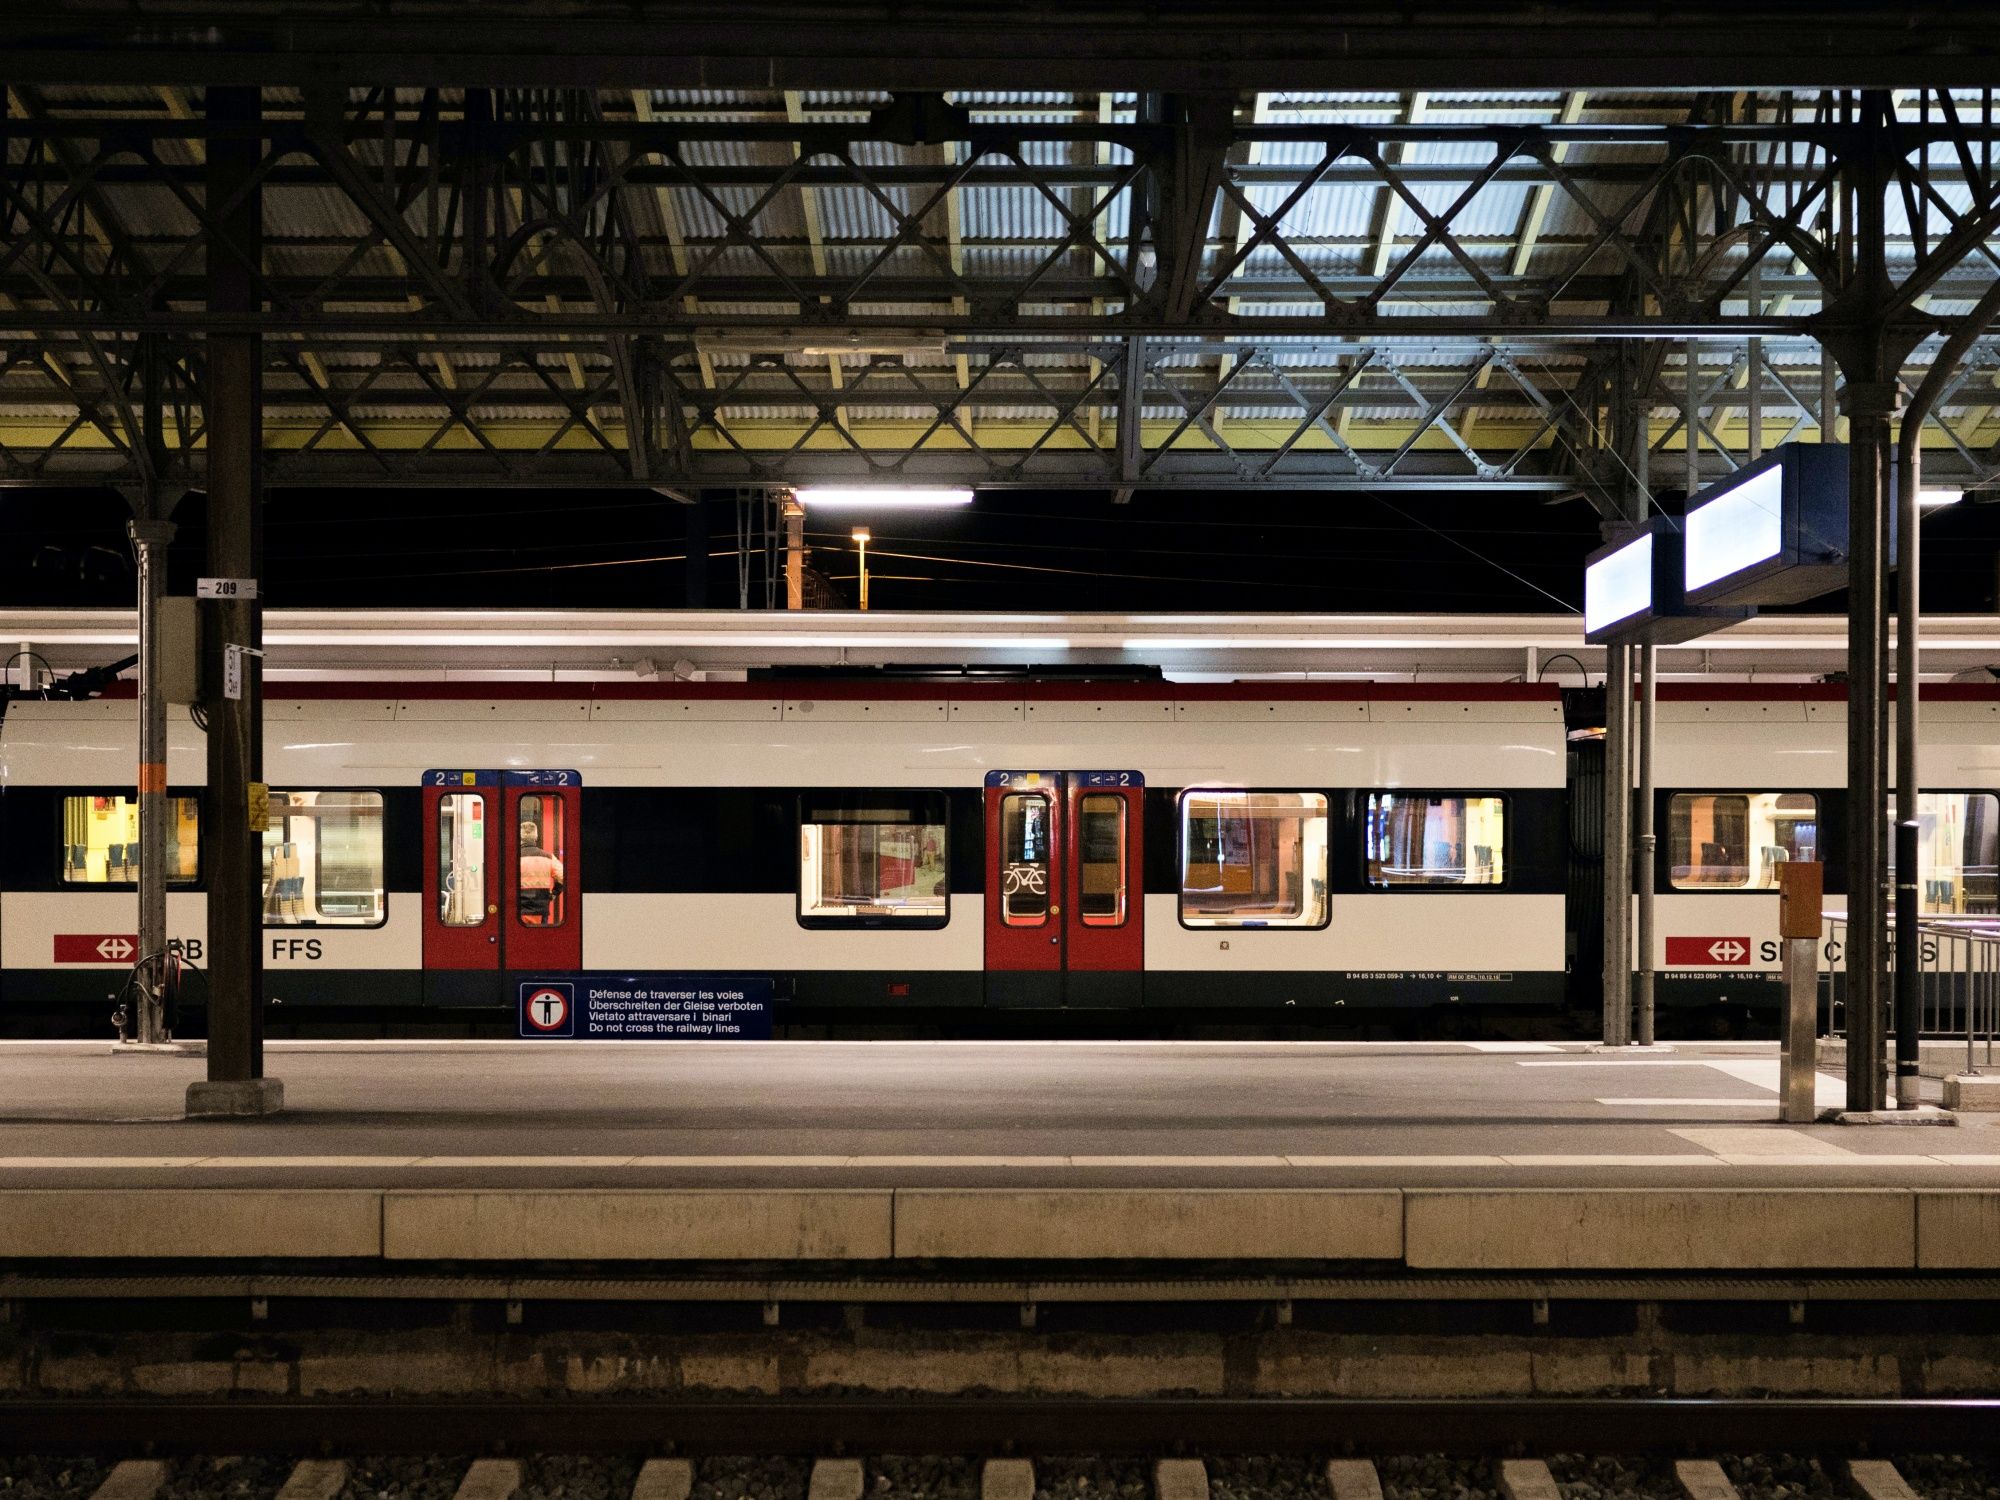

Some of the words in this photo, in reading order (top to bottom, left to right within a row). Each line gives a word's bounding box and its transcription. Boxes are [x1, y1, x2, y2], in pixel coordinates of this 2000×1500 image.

[215, 582, 237, 595] 209
[435, 772, 446, 786] 2
[558, 772, 569, 786] 2
[1000, 773, 1010, 786] 2
[1119, 773, 1130, 786] 2
[272, 939, 322, 960] FFS
[589, 989, 631, 999] Défense
[634, 990, 647, 999] de
[650, 990, 697, 999] traverser
[698, 990, 714, 1000] les
[716, 990, 744, 1000] voies
[589, 999, 661, 1010] Überschreiten
[663, 1000, 681, 1010] der
[683, 1001, 715, 1011] Gleise
[717, 1001, 763, 1011] verboten
[589, 1011, 626, 1021] Vietato
[628, 1012, 691, 1021] attraversare
[693, 1012, 697, 1021] i
[702, 1012, 731, 1022] binari
[589, 1022, 604, 1032] Do
[606, 1022, 623, 1032] not
[625, 1023, 654, 1032] cross
[656, 1023, 674, 1032] the
[676, 1023, 713, 1034] railway
[715, 1023, 740, 1033] lines
